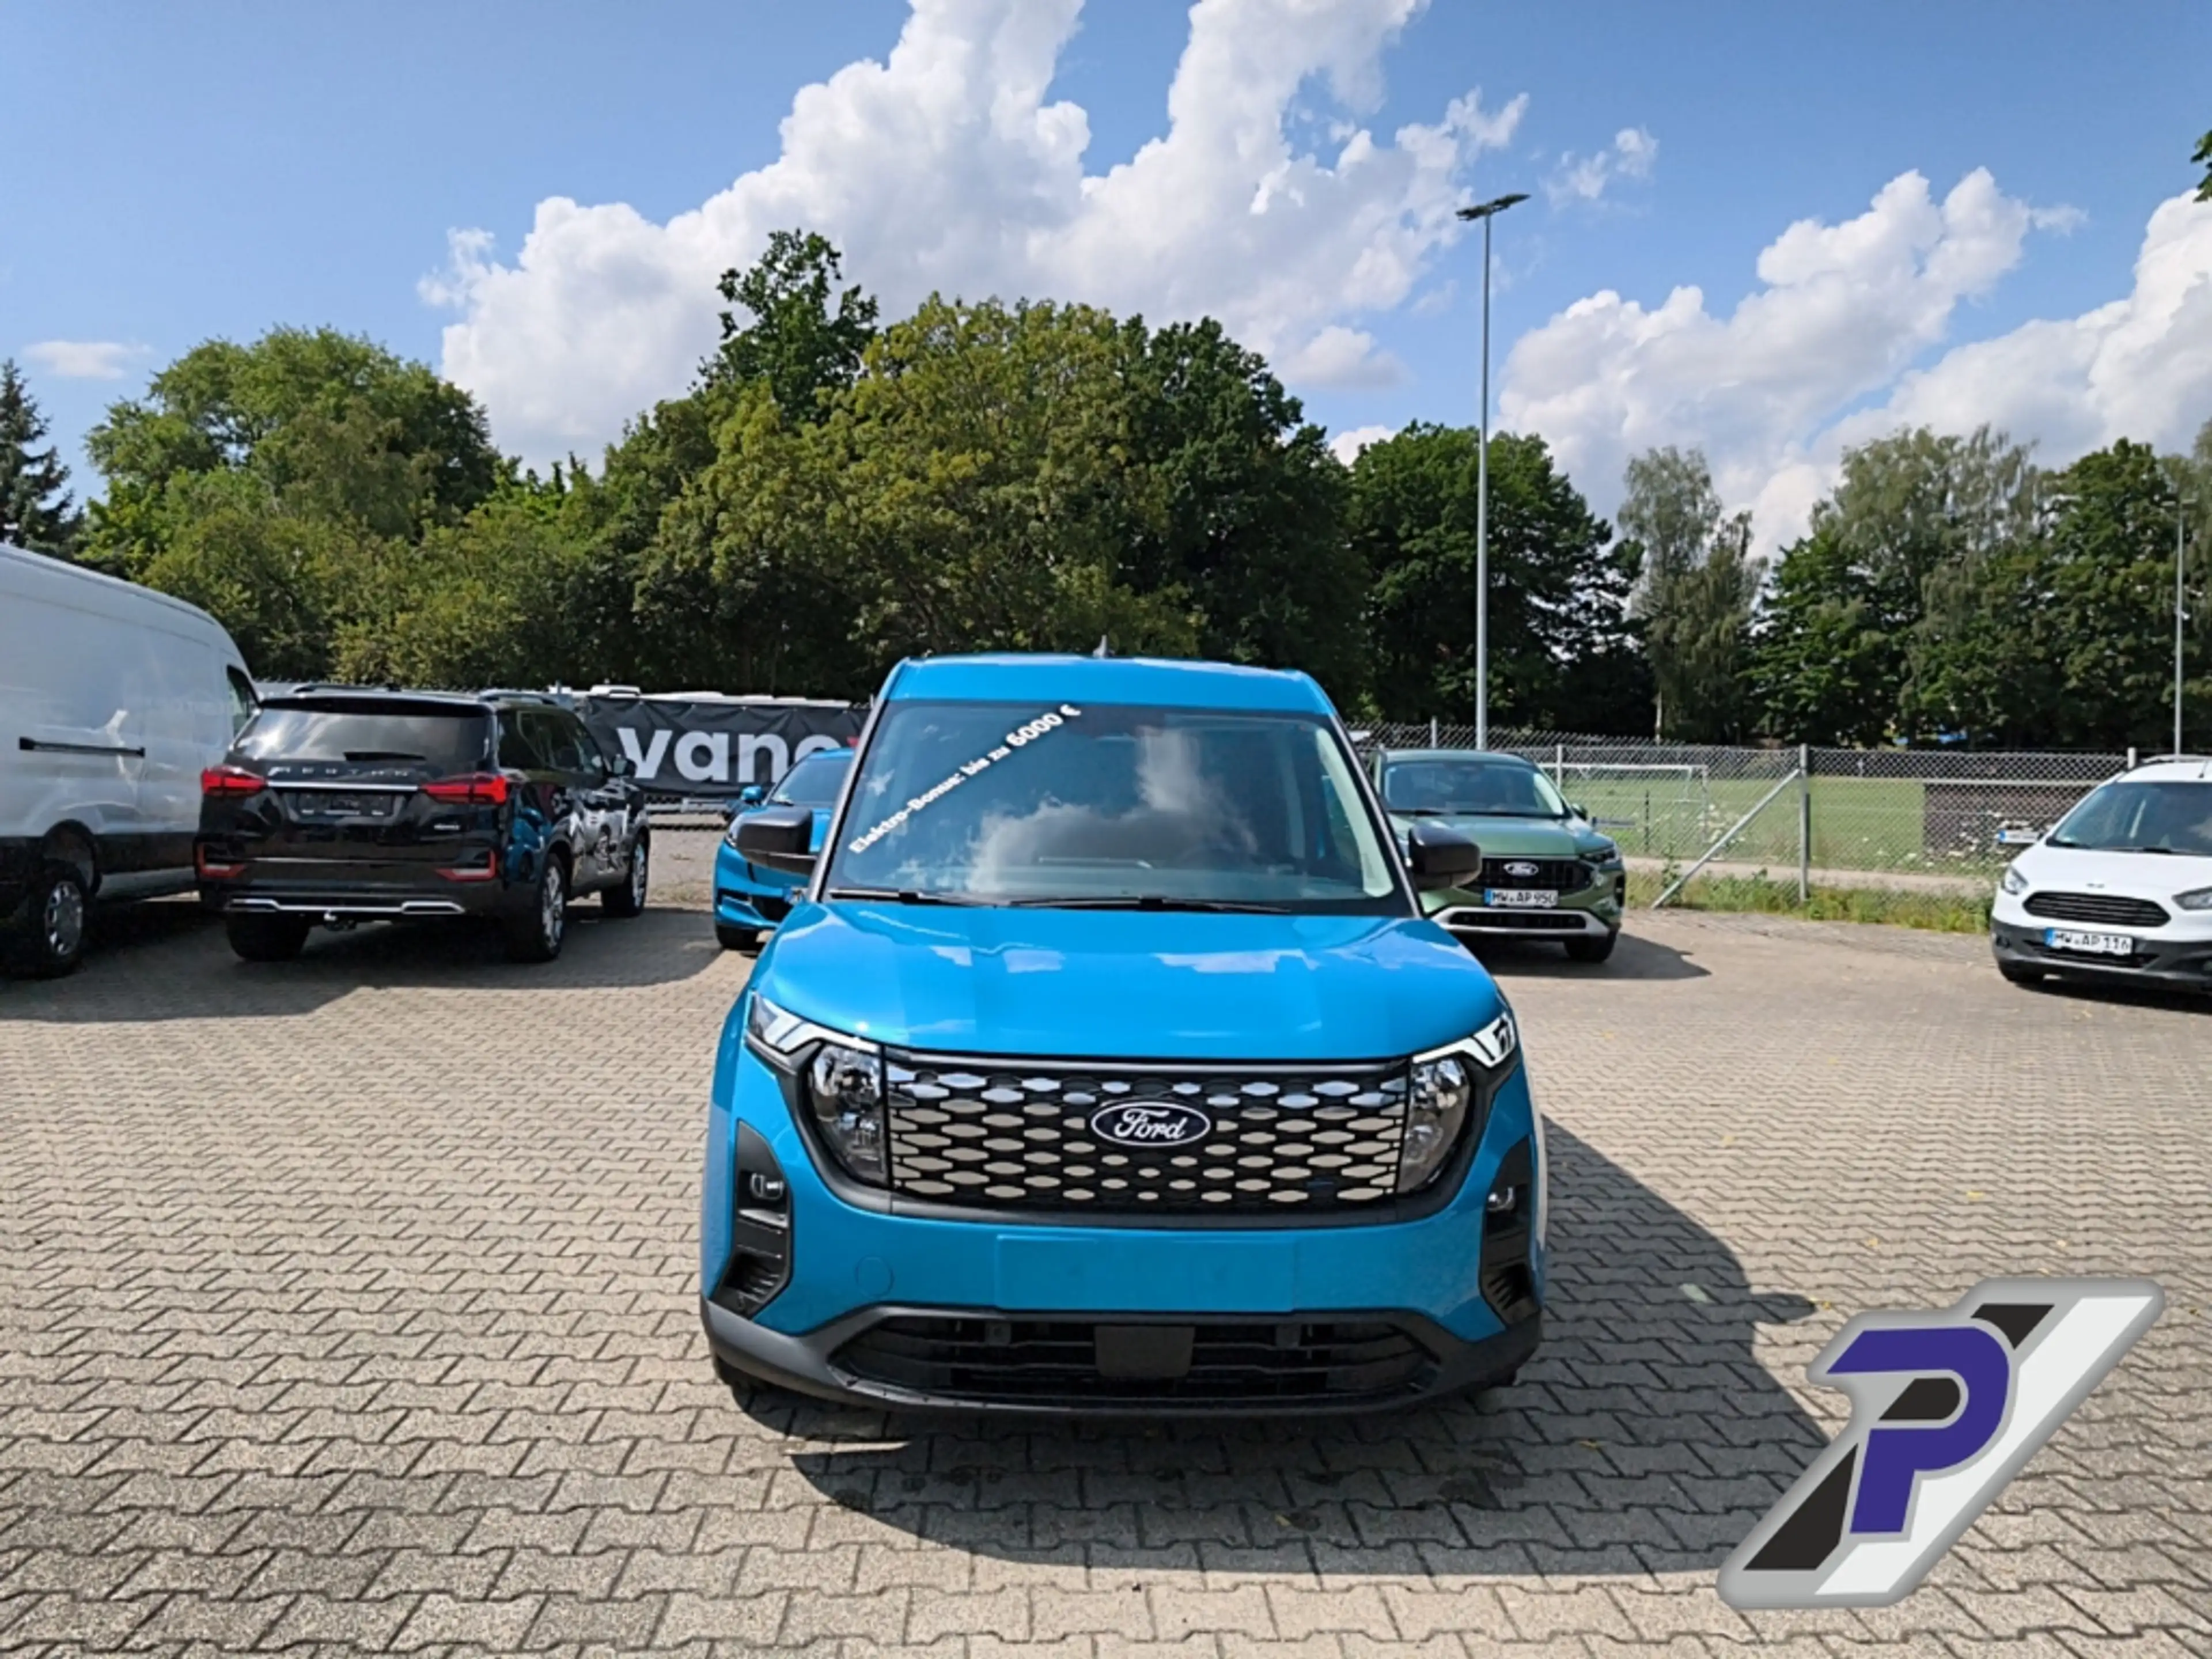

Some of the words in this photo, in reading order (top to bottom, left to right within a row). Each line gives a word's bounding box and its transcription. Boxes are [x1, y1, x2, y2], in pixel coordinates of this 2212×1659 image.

[848, 772, 967, 854] Elektro-Bonus:
[959, 757, 991, 776] bis
[987, 745, 1012, 762] zu
[1006, 712, 1064, 747] 6000
[1059, 703, 1081, 717] €
[1114, 1108, 1188, 1139] Ford
